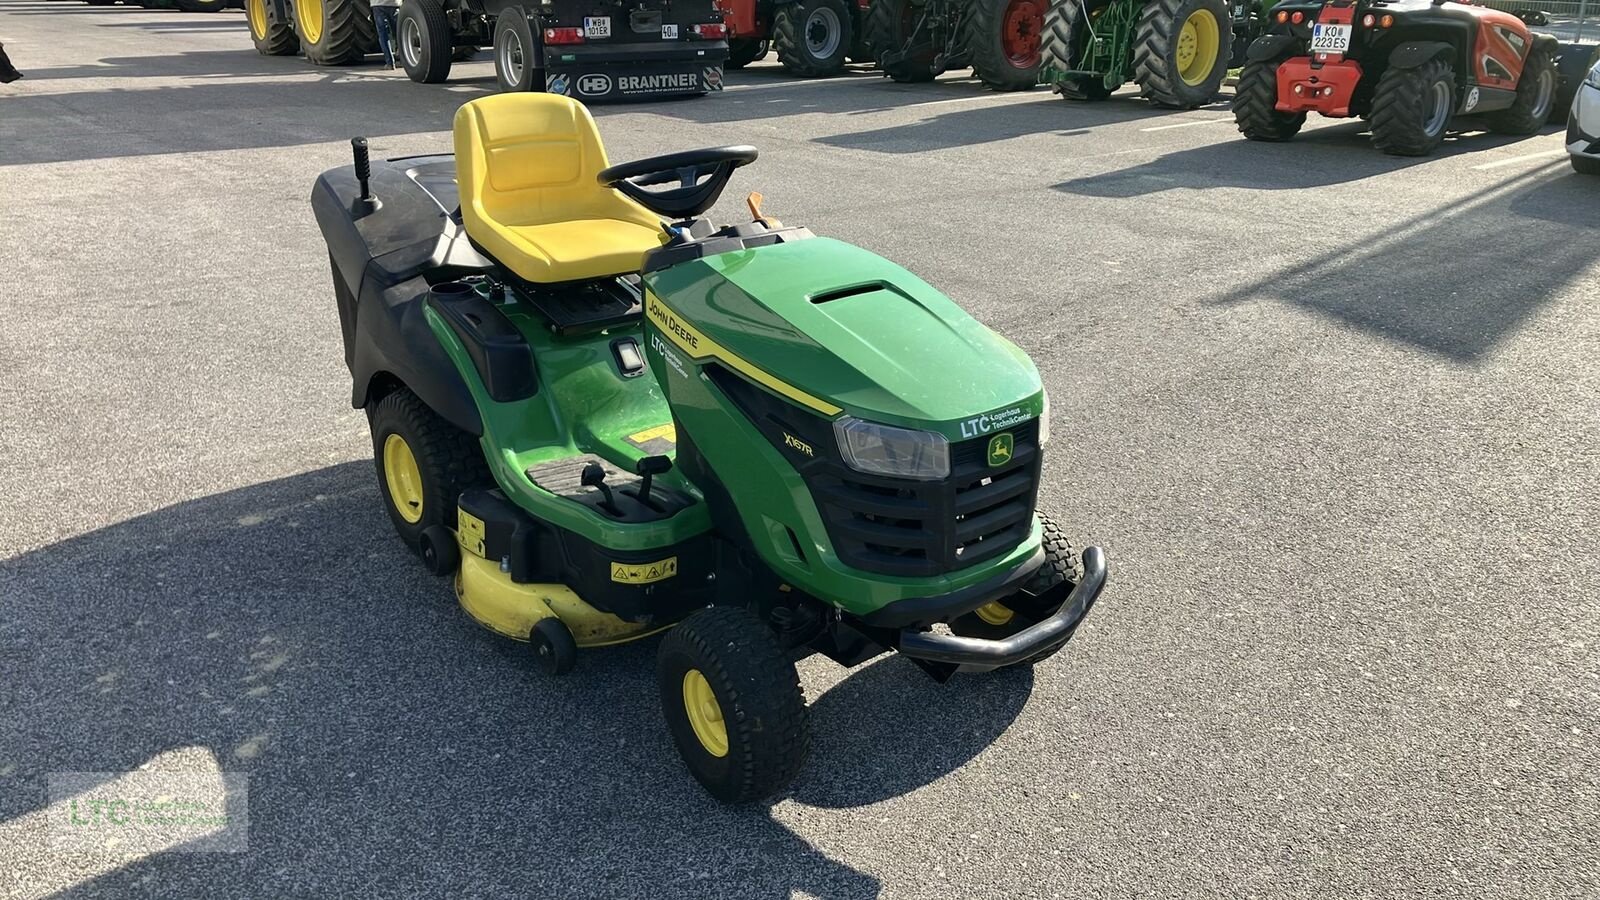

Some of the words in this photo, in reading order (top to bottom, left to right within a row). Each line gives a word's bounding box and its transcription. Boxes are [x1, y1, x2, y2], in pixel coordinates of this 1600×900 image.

[592, 18, 602, 27] WB
[589, 27, 608, 35] 101ER
[663, 26, 672, 37] 40
[1325, 26, 1338, 37] KO
[1314, 36, 1347, 49] 223ES
[583, 78, 608, 91] HB
[618, 73, 698, 90] BRANTNER
[648, 299, 669, 326] JOHN
[668, 315, 699, 350] DEERE
[651, 333, 665, 356] LTC
[990, 407, 1021, 421] Lagerhaus
[960, 415, 991, 438] LTC
[991, 413, 1032, 430] TechnikCenter
[782, 431, 814, 457] X167R
